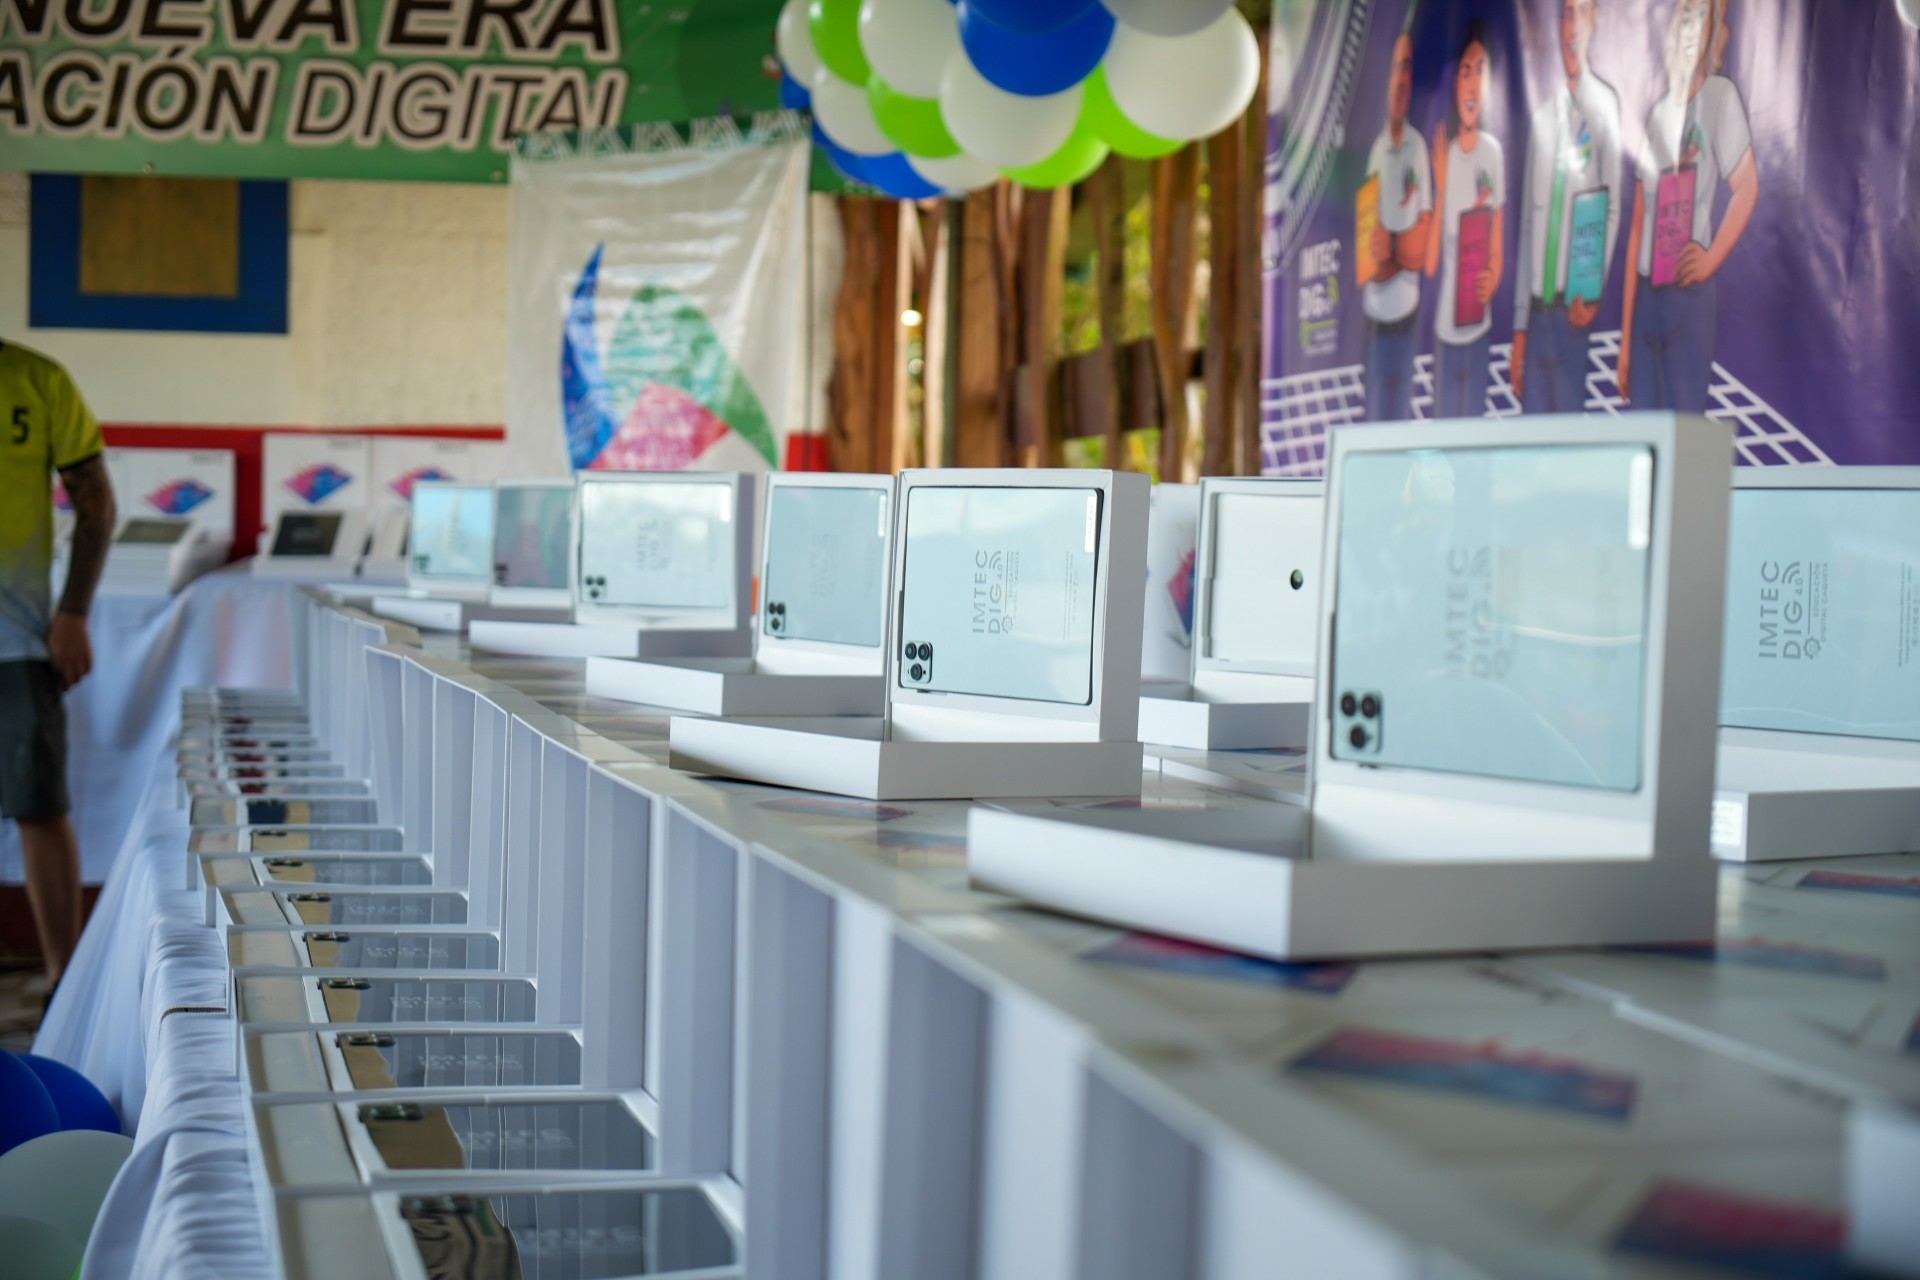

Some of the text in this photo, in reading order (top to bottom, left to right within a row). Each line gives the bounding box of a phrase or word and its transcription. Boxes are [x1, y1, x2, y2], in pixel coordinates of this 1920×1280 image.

[386, 0, 609, 52] ERA
[12, 407, 30, 444] 5
[972, 549, 988, 633] IMTEC
[988, 583, 1003, 635] DIG
[1758, 561, 1780, 658] IMTEC
[1783, 599, 1803, 659] DIG
